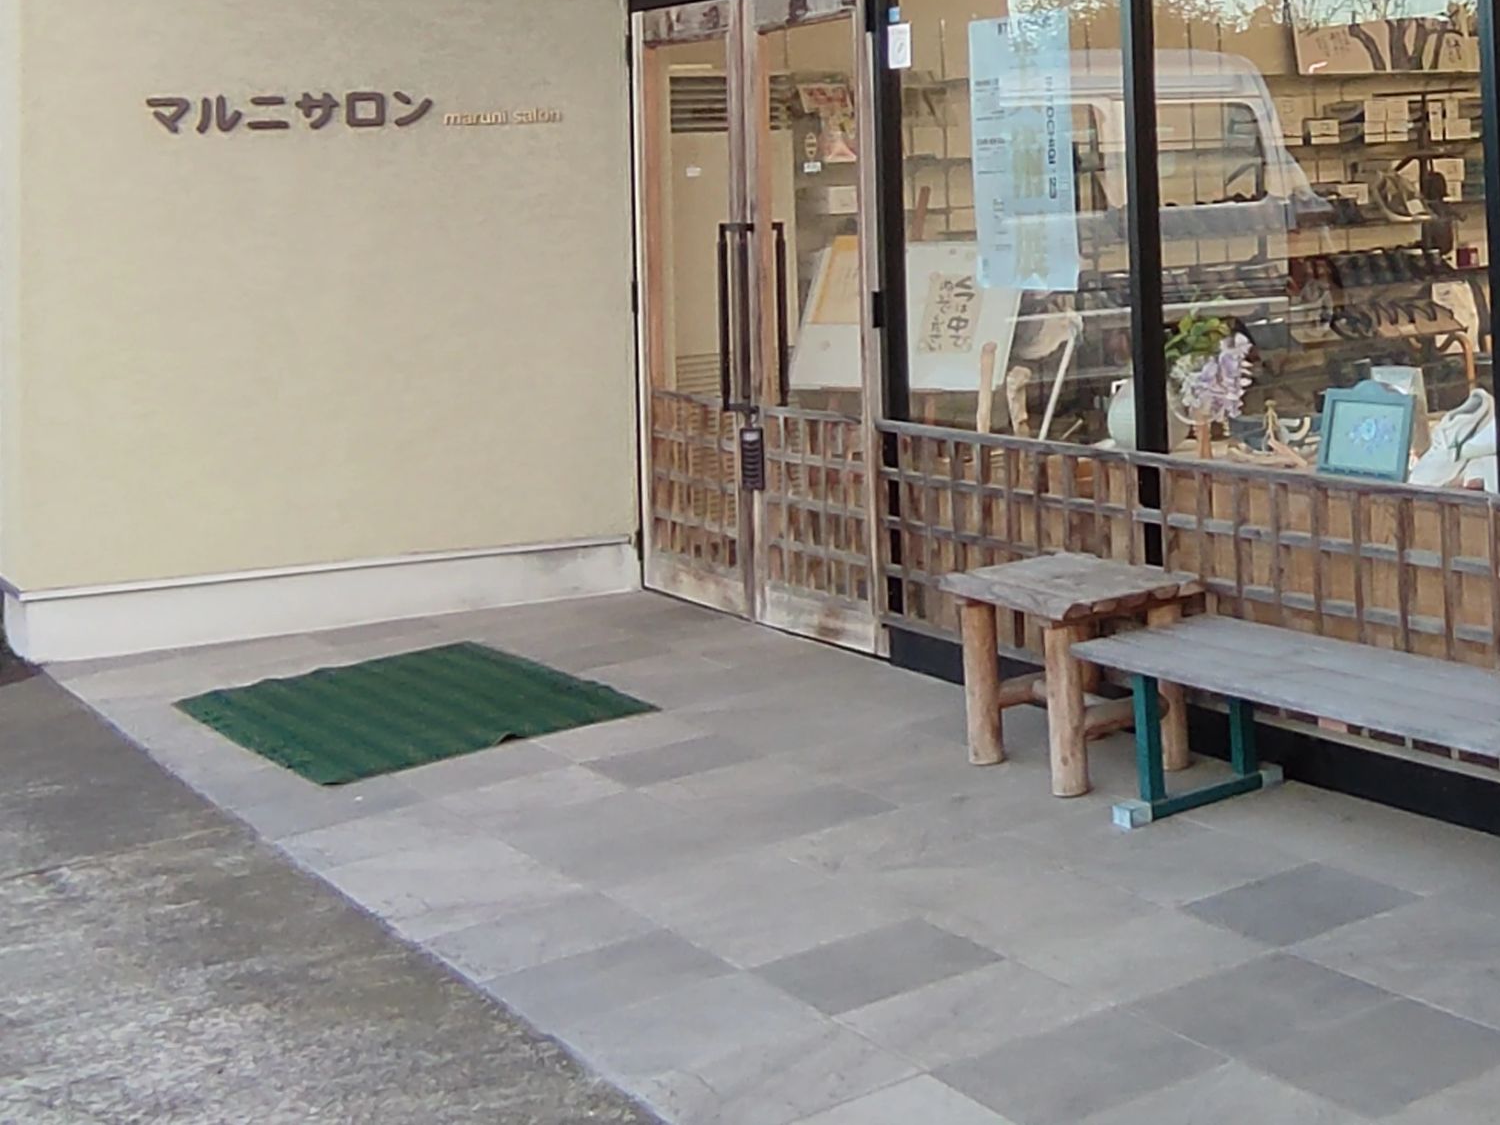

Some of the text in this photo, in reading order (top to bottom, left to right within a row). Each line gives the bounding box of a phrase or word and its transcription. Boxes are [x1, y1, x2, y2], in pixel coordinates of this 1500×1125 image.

[146, 90, 434, 134] マルニサロン
[442, 107, 562, 126] maruni salon
